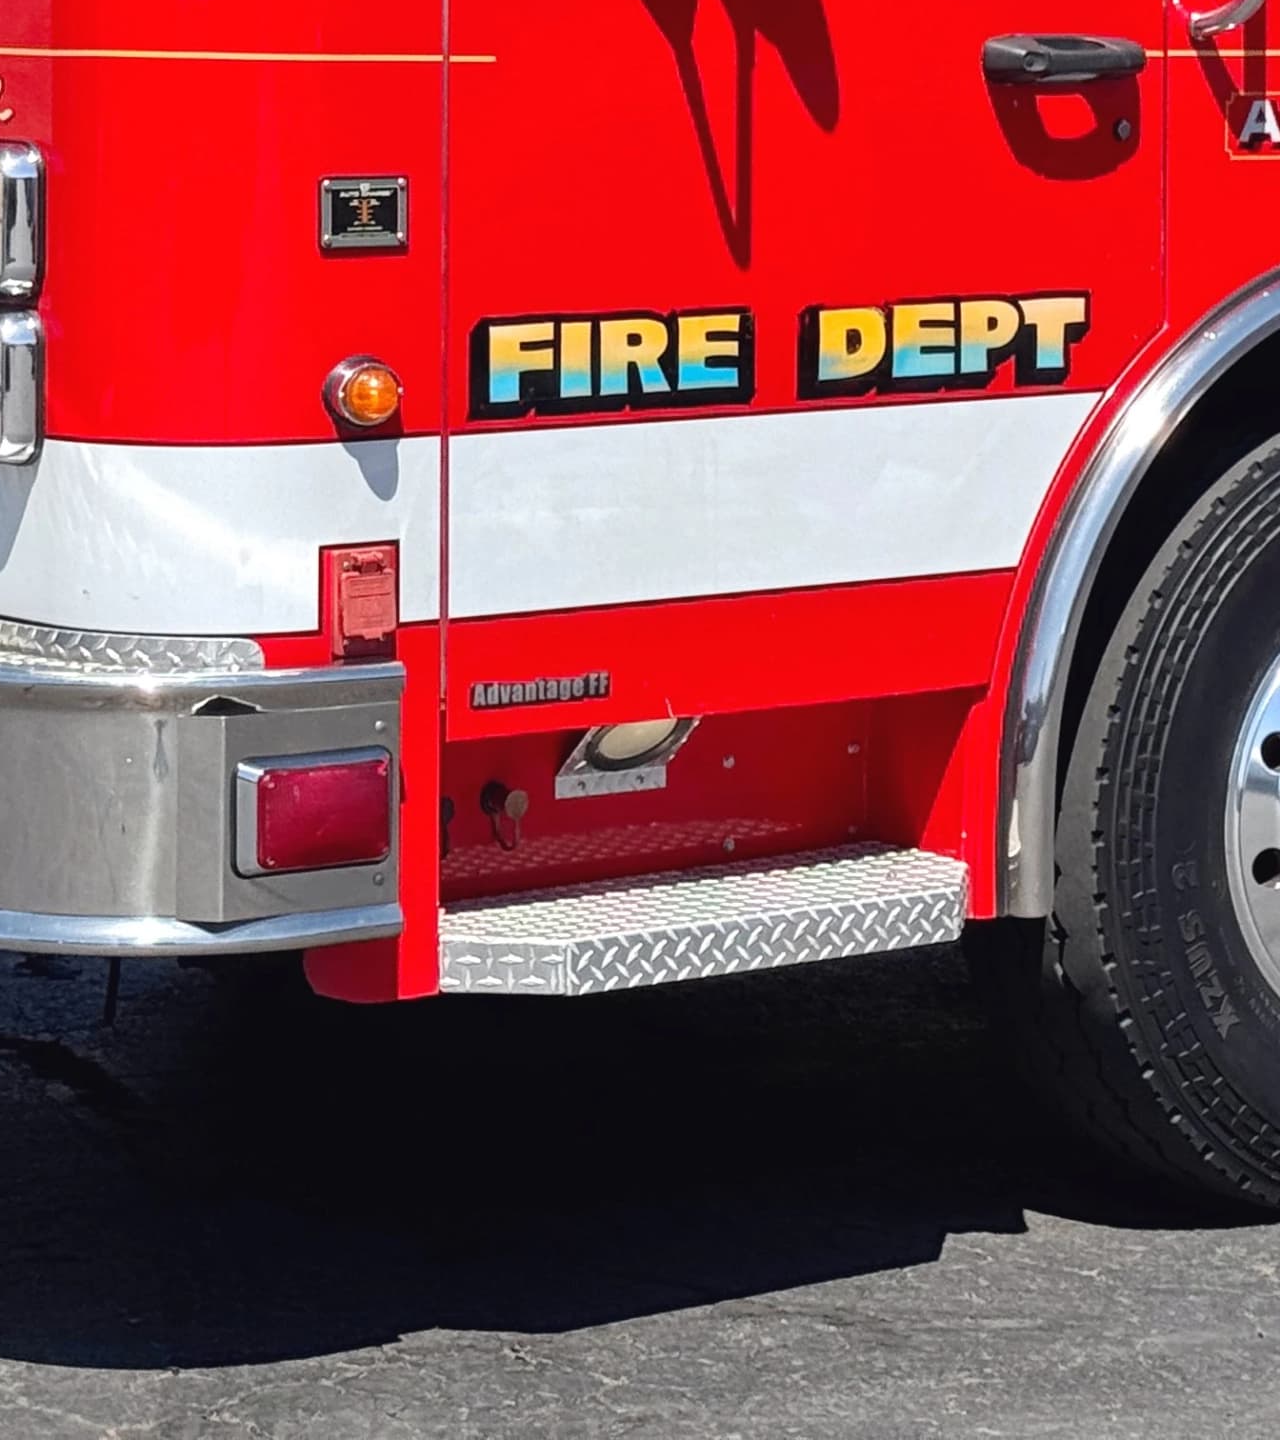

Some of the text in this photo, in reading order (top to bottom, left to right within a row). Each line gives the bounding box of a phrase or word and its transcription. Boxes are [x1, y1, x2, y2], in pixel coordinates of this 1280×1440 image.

[484, 295, 1086, 408] FIRE DEPT
[472, 671, 609, 707] Advantage FF
